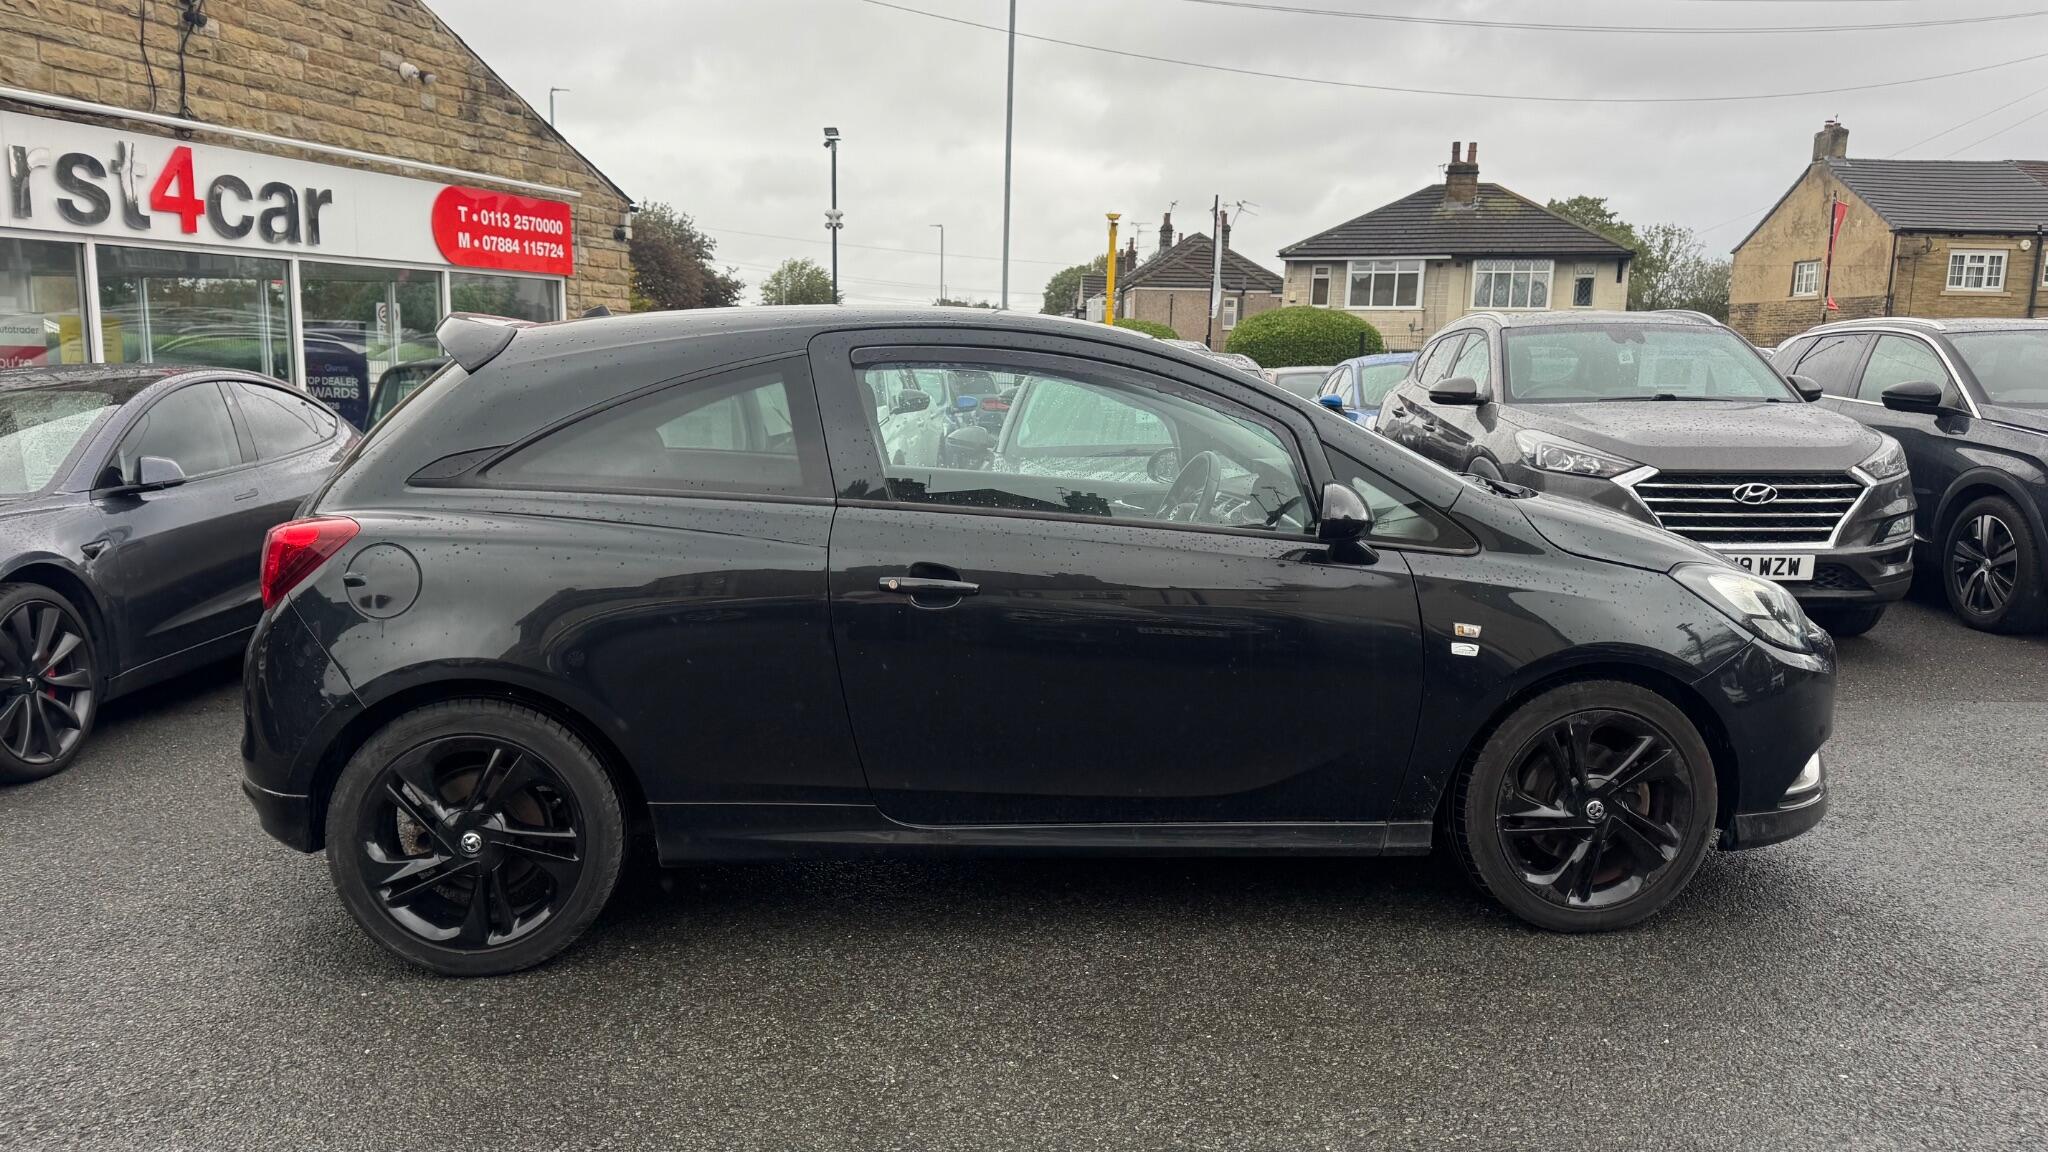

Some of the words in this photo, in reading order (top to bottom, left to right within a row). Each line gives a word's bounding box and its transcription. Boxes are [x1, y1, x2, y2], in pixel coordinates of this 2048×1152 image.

[457, 205, 468, 222] T
[480, 209, 511, 228] 0113
[514, 214, 563, 235] 2570000
[458, 232, 470, 248] M
[482, 234, 520, 253] 07884
[523, 240, 564, 258] 115724
[322, 376, 359, 387] DEALER
[1759, 557, 1801, 576] WZW
